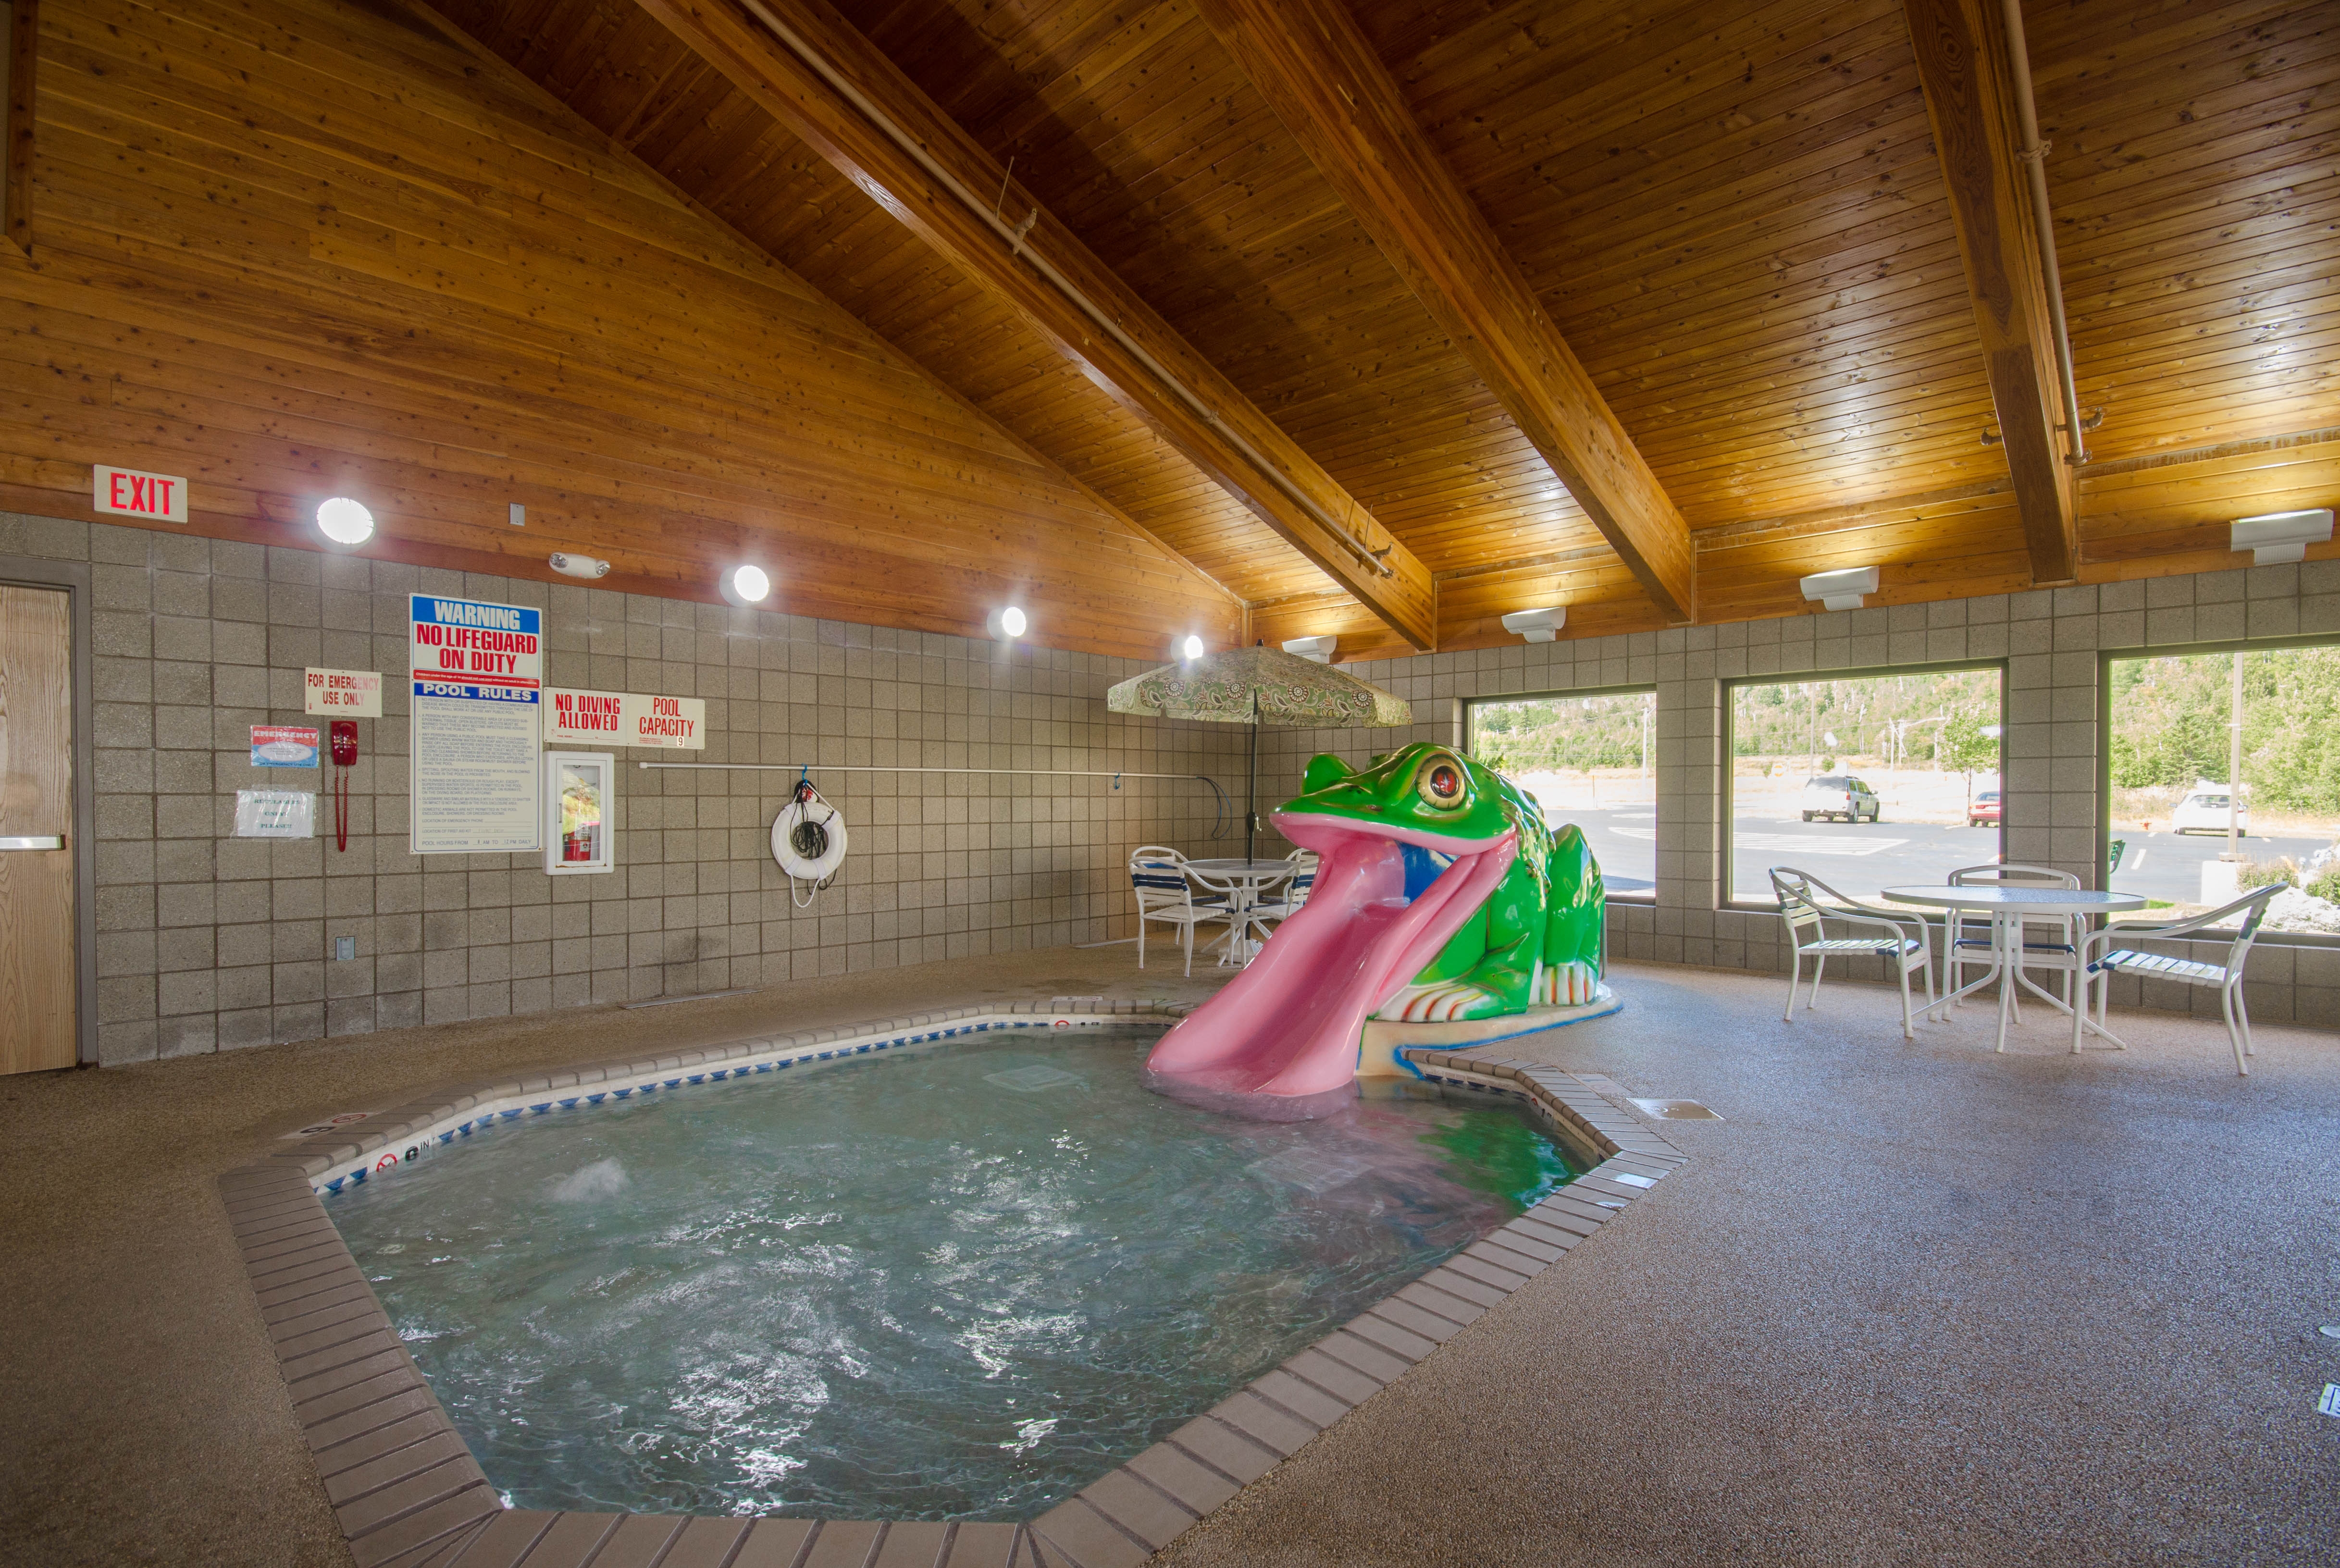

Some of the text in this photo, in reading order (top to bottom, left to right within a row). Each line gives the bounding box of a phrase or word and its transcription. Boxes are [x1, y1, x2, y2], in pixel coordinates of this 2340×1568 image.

[110, 472, 174, 515] EXIT
[434, 600, 520, 630] WARNING
[417, 624, 537, 654] NO LIFEGUARD
[439, 648, 517, 674] ON DUTY
[308, 674, 379, 691] FOR EMERGENCY
[423, 683, 532, 701] POOL RULES
[323, 691, 364, 705] USE ONLY
[556, 693, 620, 714] NO DIVING
[654, 697, 681, 716] POOL
[558, 711, 618, 731] ALLOWED
[639, 716, 694, 737] CAPACITY
[678, 737, 683, 746] 9
